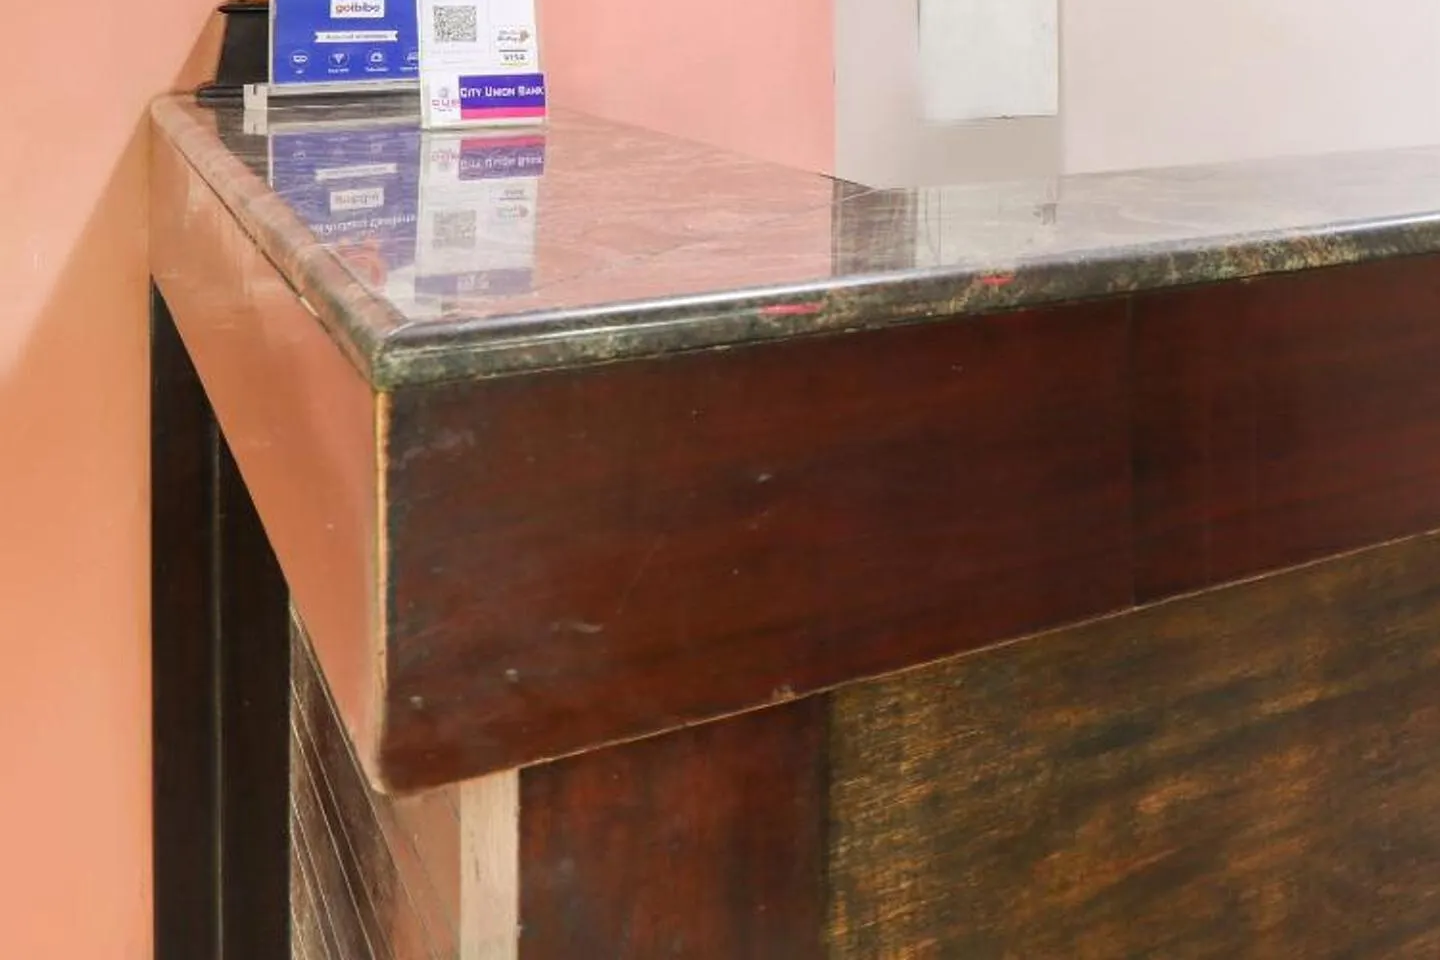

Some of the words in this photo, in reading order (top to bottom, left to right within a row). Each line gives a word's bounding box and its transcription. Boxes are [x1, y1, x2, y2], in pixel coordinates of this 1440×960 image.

[335, 2, 381, 14] goibibo
[460, 86, 482, 98] CITY
[485, 85, 516, 98] UNION
[518, 84, 545, 96] BANK
